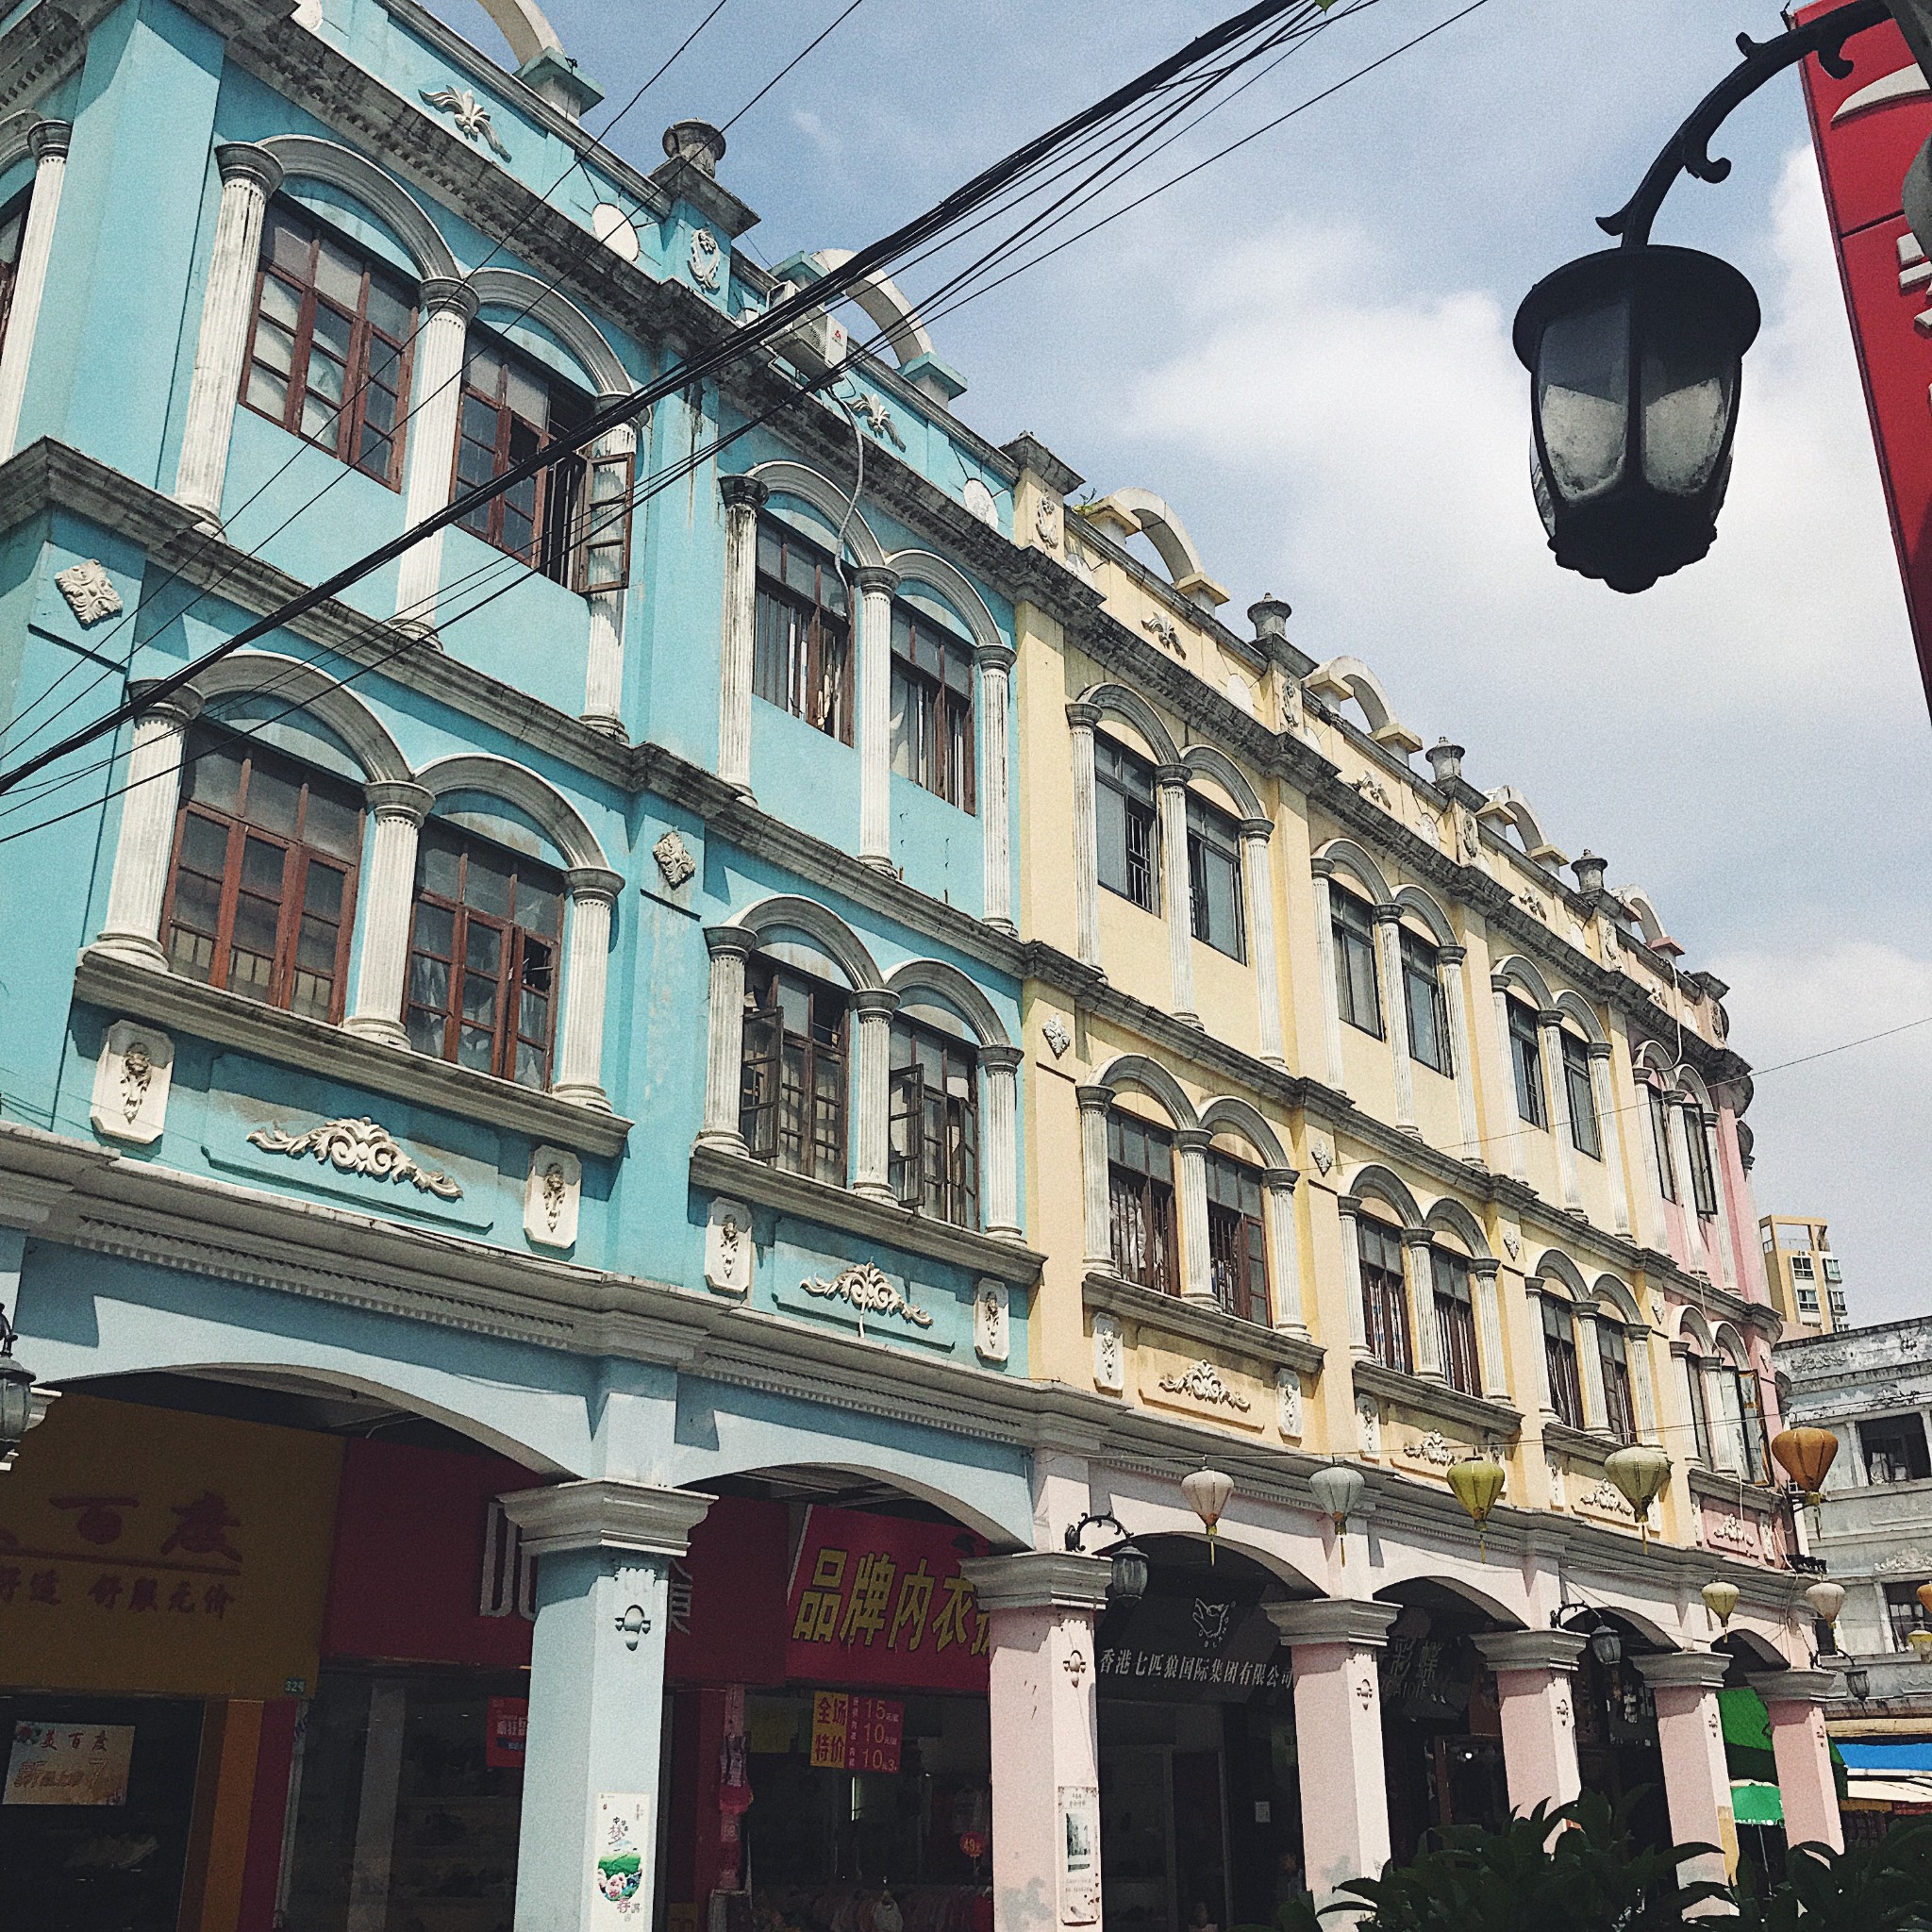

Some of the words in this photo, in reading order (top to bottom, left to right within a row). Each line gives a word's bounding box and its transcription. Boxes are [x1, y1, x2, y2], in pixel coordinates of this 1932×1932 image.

[1100, 1647, 1293, 1690] 香港七匹狼国际集团有限公司
[1381, 1638, 1444, 1683] 彩蝶
[817, 1697, 845, 1726] 全场
[41, 1728, 108, 1752] 美百度
[816, 1734, 844, 1762] 特价
